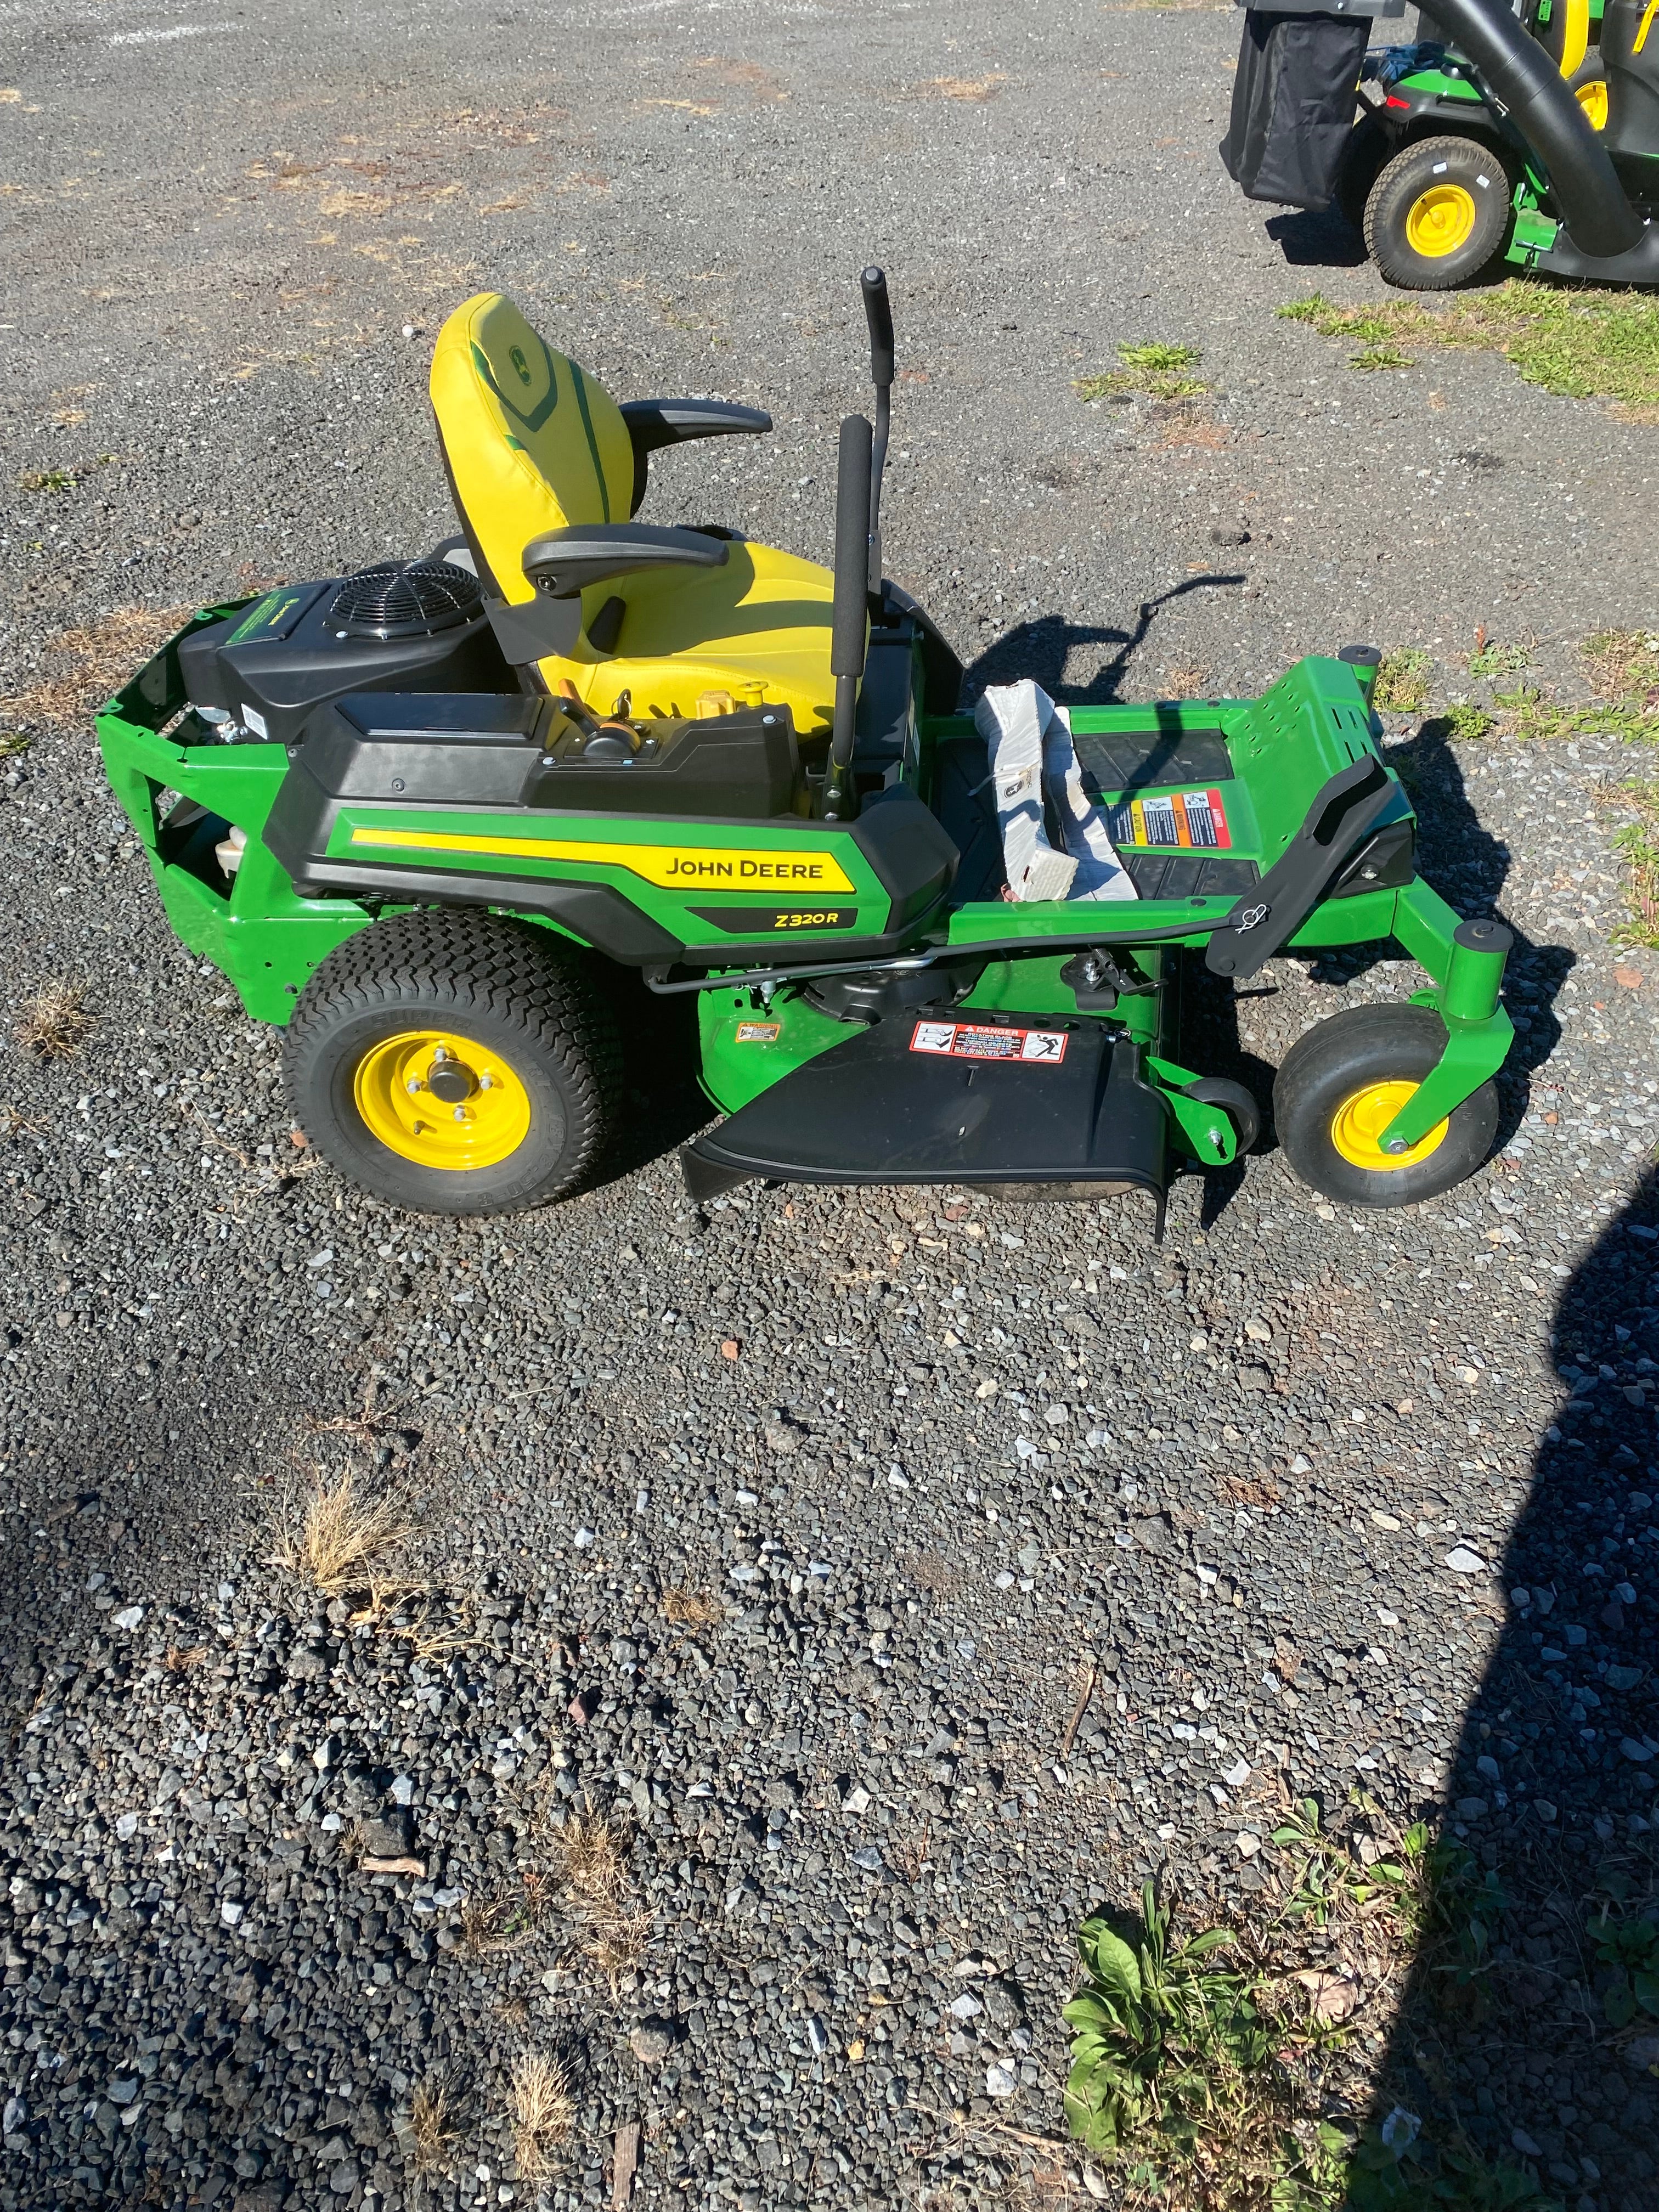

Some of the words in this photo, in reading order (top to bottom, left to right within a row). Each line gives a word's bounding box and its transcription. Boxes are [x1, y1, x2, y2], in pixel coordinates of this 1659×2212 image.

[1135, 816, 1143, 832] CAUTION
[1176, 814, 1186, 831] WARNING
[1214, 814, 1224, 828] DANGER
[665, 857, 732, 876] JOHN
[740, 860, 823, 878] DEERE
[774, 912, 838, 928] Z320R
[371, 1008, 472, 1030] SUPER
[976, 1026, 1019, 1036] DANGER
[490, 1032, 556, 1092] TURF
